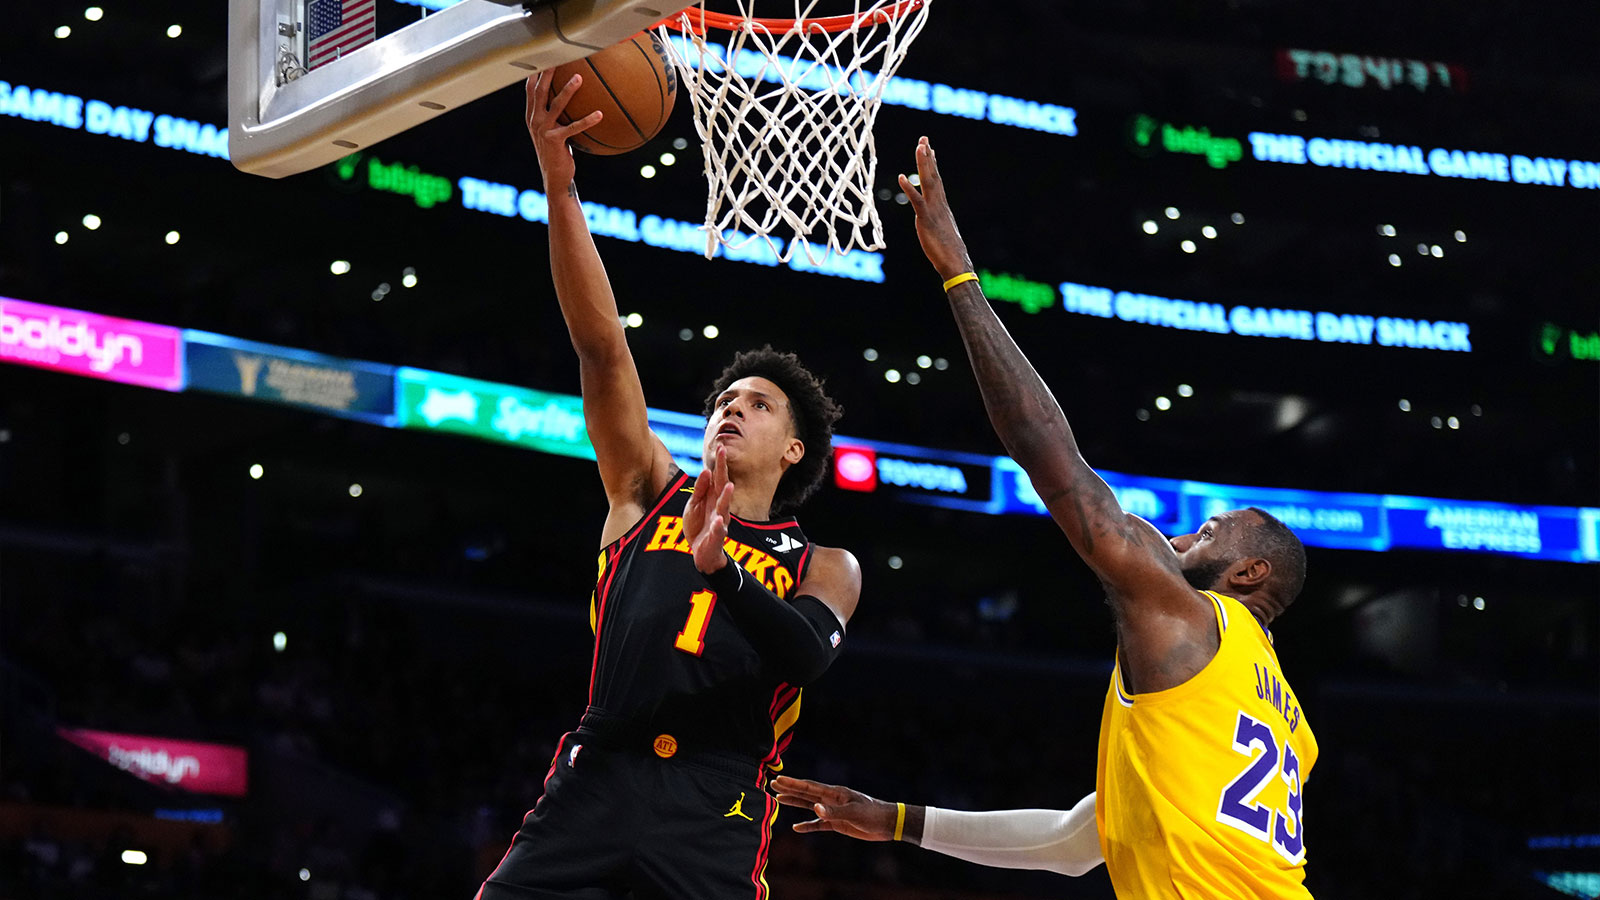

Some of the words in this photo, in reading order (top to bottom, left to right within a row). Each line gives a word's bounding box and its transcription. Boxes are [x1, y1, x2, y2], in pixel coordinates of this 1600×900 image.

[85, 100, 154, 142] DAY
[931, 83, 989, 120] DAY
[987, 94, 1078, 137] SNACK
[1248, 131, 1307, 164] THE
[1306, 137, 1430, 175] OFFICIAL
[1428, 147, 1511, 182] GAME
[1510, 154, 1568, 187] DAY
[458, 176, 519, 217] THE
[0, 303, 143, 374] boldyn
[1059, 281, 1116, 318] THE
[1113, 290, 1231, 334] OFFICIAL
[1229, 305, 1315, 341] GAME
[1315, 311, 1376, 345] DAY
[1374, 317, 1473, 353] SNACK
[876, 457, 968, 494] TOYOTA
[765, 536, 778, 545] the
[1426, 506, 1539, 531] AMERICAN
[1442, 527, 1541, 553] EXPRESS
[644, 515, 794, 600] HWKS
[674, 588, 717, 657] 1
[1254, 662, 1300, 734] JAMES
[656, 739, 674, 752] ATL
[1216, 709, 1306, 866] 23
